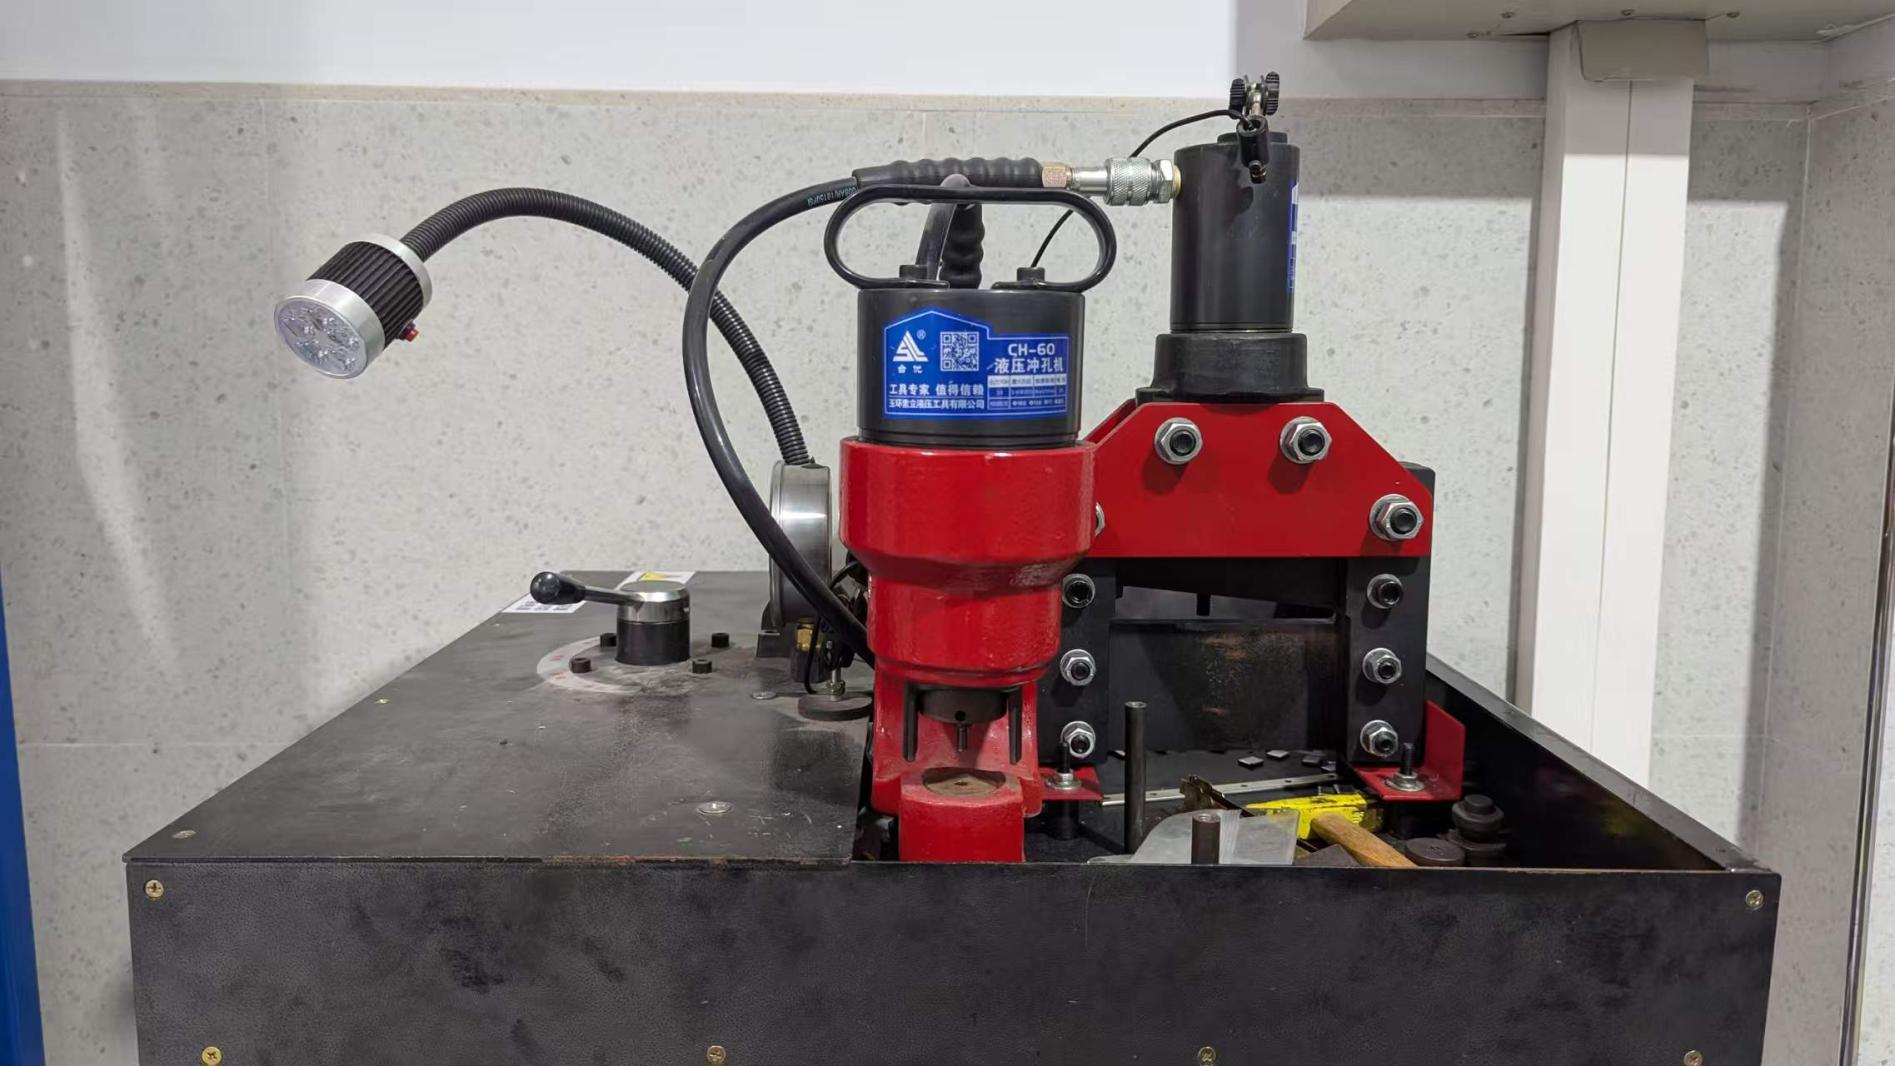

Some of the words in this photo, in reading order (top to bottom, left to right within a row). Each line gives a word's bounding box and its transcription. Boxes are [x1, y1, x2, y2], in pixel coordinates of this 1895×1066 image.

[1007, 343, 1056, 357] CH-60
[994, 357, 1063, 373] 液压冲孔机
[889, 383, 930, 396] 工具专家
[936, 383, 984, 396] 值得信赖
